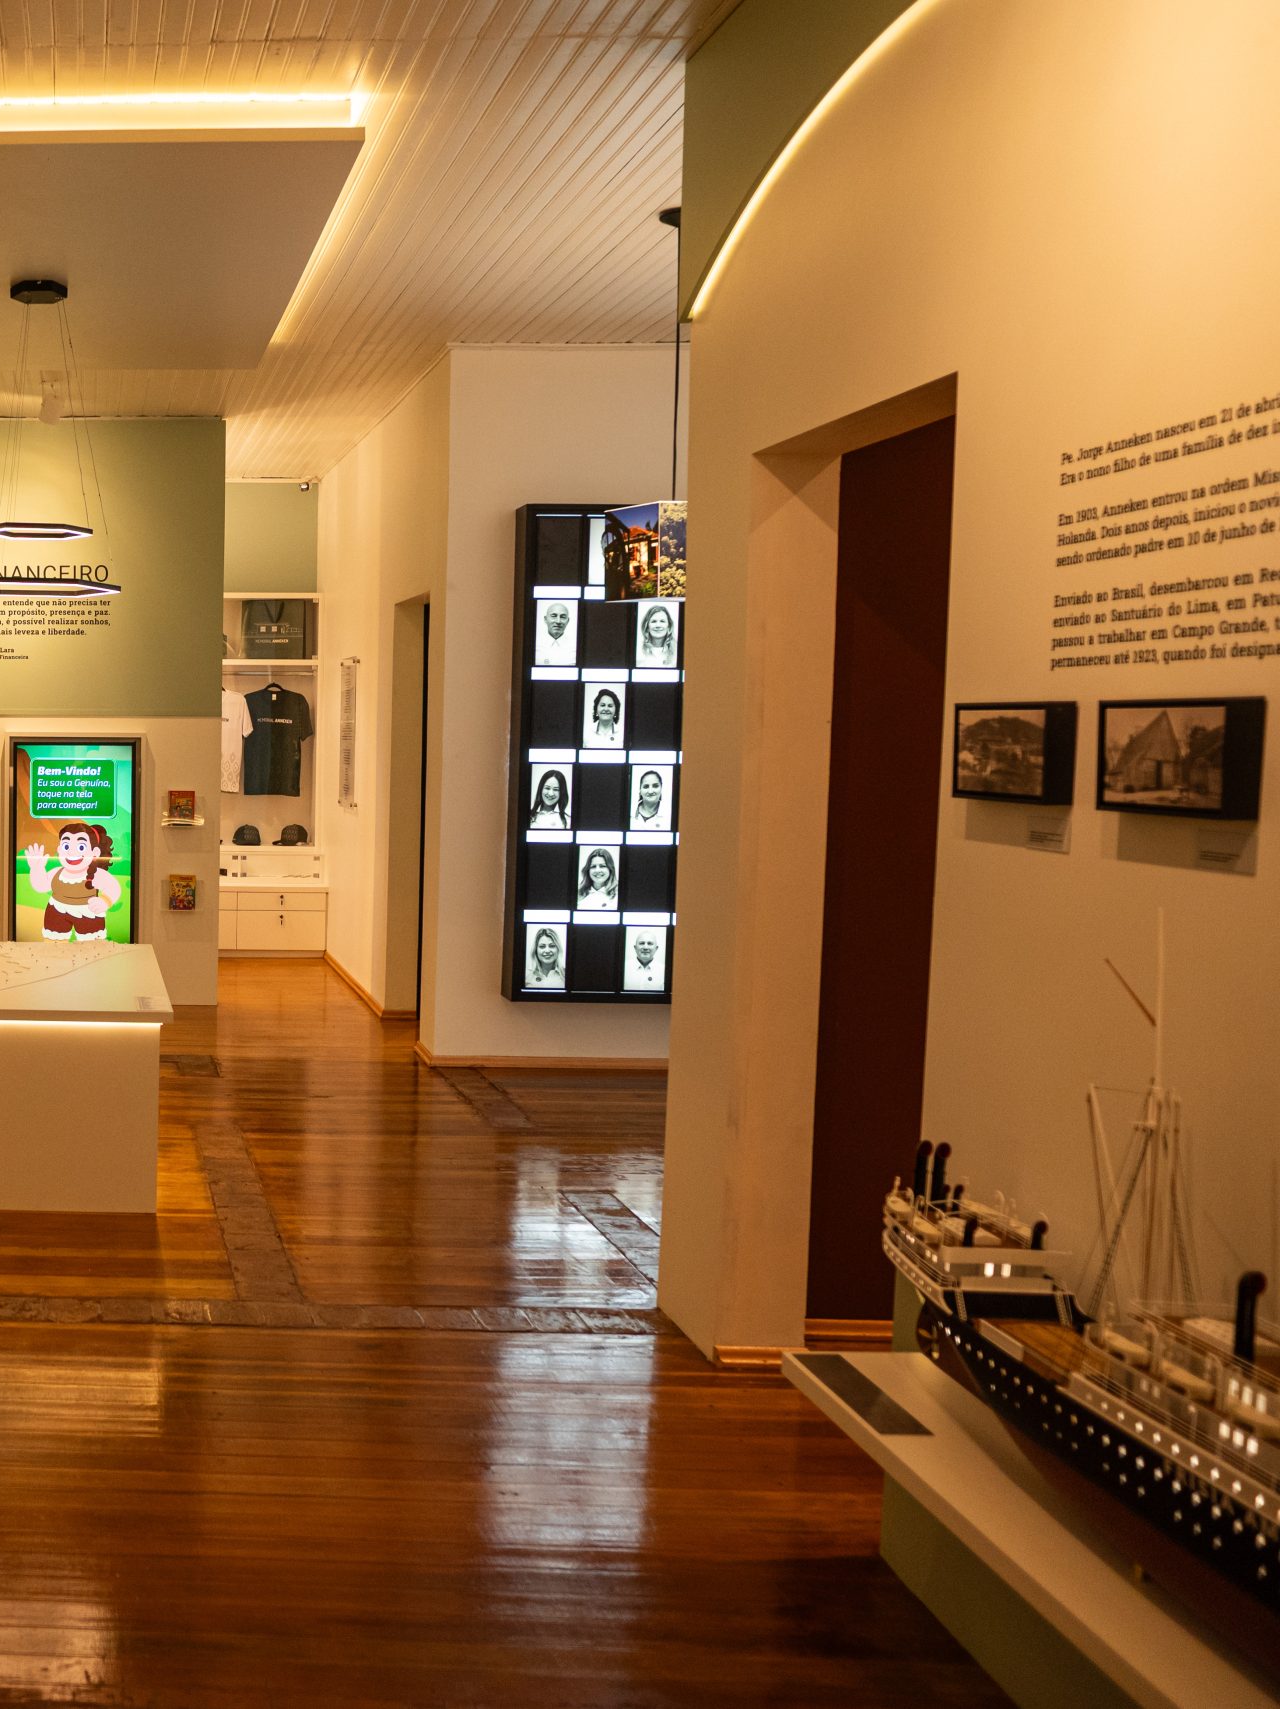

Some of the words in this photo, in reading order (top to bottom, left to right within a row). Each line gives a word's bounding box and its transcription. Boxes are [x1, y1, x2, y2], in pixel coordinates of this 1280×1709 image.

[2, 598, 34, 606] entende
[35, 600, 50, 608] que
[52, 598, 67, 606] não
[69, 598, 98, 608] precisa
[8, 608, 48, 617] propósito,
[12, 617, 45, 627] possível
[80, 618, 110, 626] sonhos,
[37, 766, 101, 776] Bem-Vindo!
[37, 779, 48, 787] Eu
[74, 778, 111, 788] Genuína,
[37, 790, 61, 799] toque
[76, 790, 93, 798] tela
[37, 802, 57, 810] para
[58, 801, 98, 811] começar!
